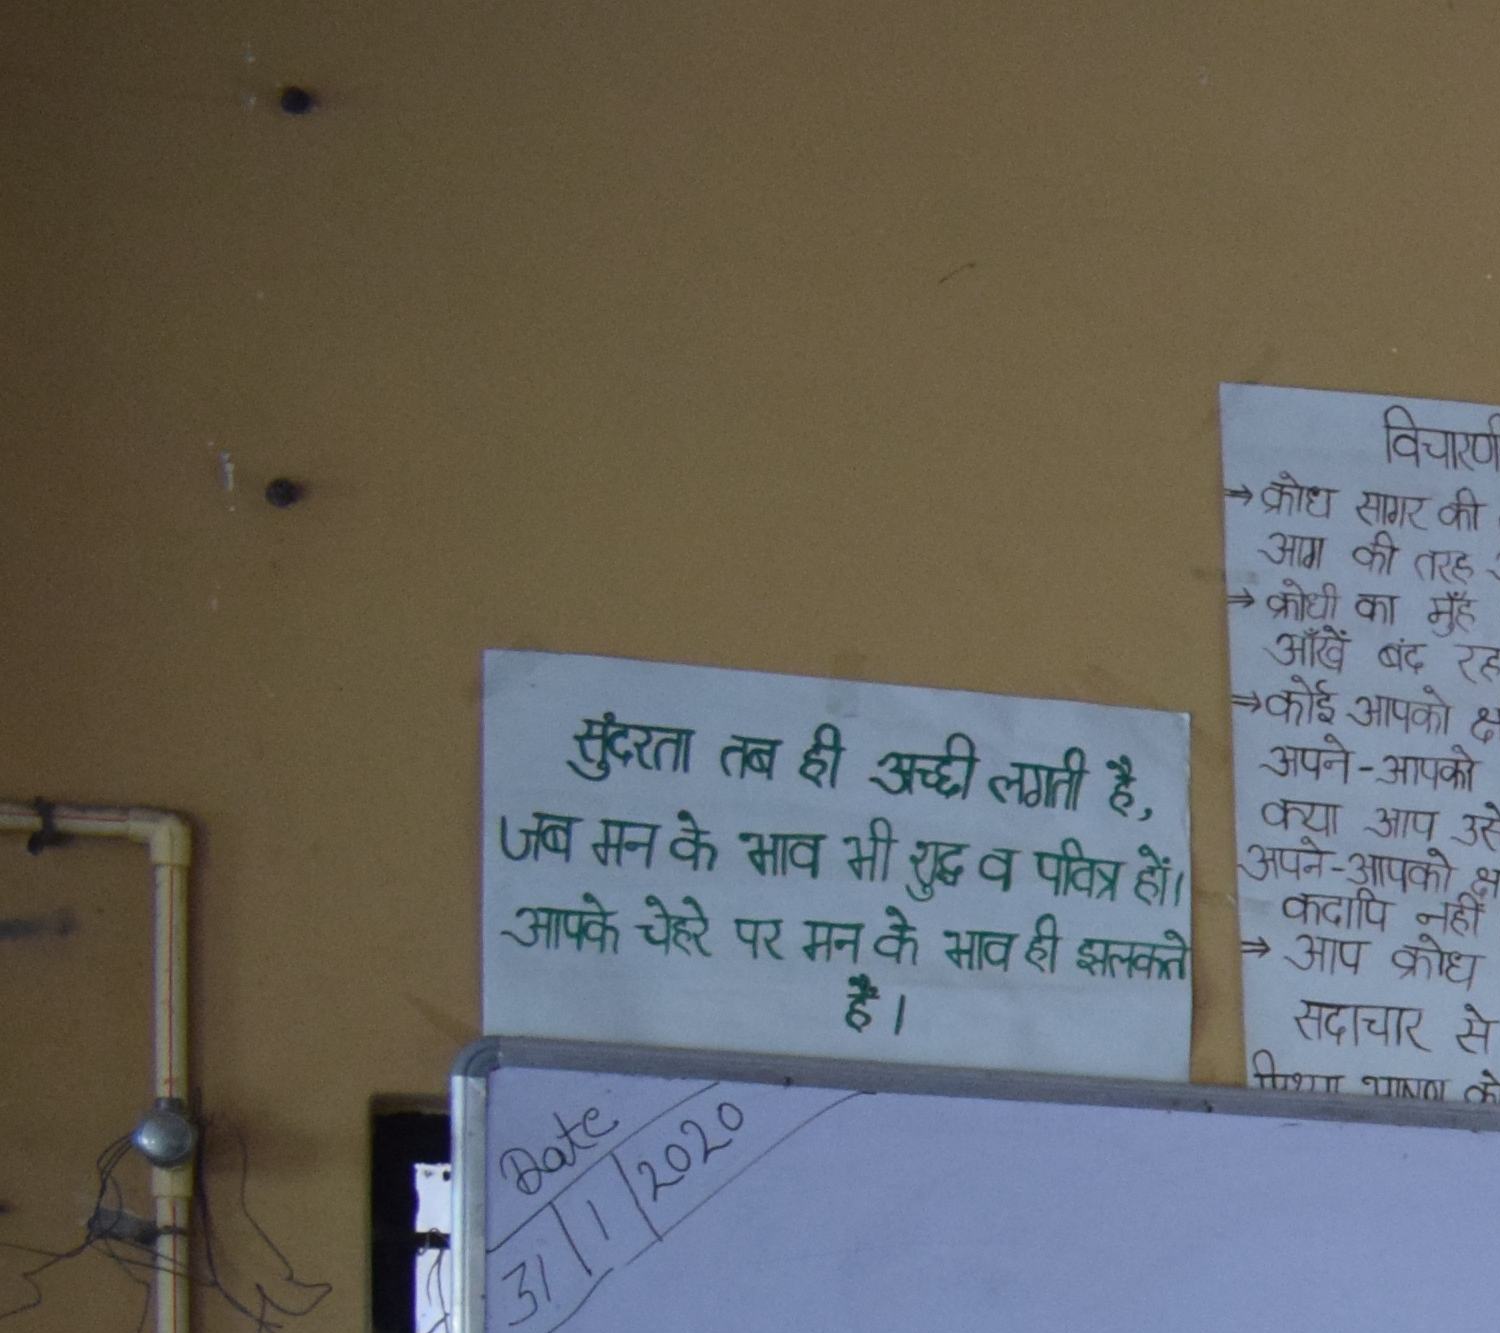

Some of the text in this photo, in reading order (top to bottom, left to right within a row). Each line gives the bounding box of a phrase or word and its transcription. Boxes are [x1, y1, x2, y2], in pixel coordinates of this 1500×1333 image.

[1261, 471, 1341, 519] क्रोध
[1355, 490, 1430, 531] सागर
[1438, 486, 1489, 531] की
[1257, 531, 1327, 570] आग
[1352, 530, 1400, 575] की
[1413, 550, 1474, 583] तरह
[1266, 578, 1342, 622] क्रोधी
[1354, 593, 1400, 626] का
[1427, 590, 1478, 638] मुँह
[1263, 625, 1352, 674] आँखें
[1377, 638, 1428, 674] बंद
[1265, 674, 1339, 726] कोई
[1346, 685, 1454, 735] आपको
[567, 711, 696, 782] सुंदरता
[720, 734, 783, 780] तब
[799, 723, 847, 789] ही
[869, 732, 981, 799] अच्छी
[988, 746, 1091, 811] लगती
[1261, 798, 1344, 838] क्या
[1363, 806, 1441, 842] आप
[501, 811, 584, 862] जब
[592, 818, 662, 869] मन
[669, 809, 718, 871] के
[738, 831, 828, 879] भाव
[843, 816, 898, 882] भी
[905, 840, 970, 902] शुद्ध
[979, 847, 1022, 892] व
[1034, 837, 1127, 901] पवित्र
[500, 892, 1192, 980] आपके चेहरे पर मन के भाव ही झलकते
[1282, 887, 1397, 932] कदापि
[1284, 934, 1372, 975] आप
[1391, 933, 1486, 992] क्रोध
[1294, 999, 1432, 1052] सदाचार
[1456, 1002, 1500, 1055] से
[501, 1107, 619, 1195] Date
